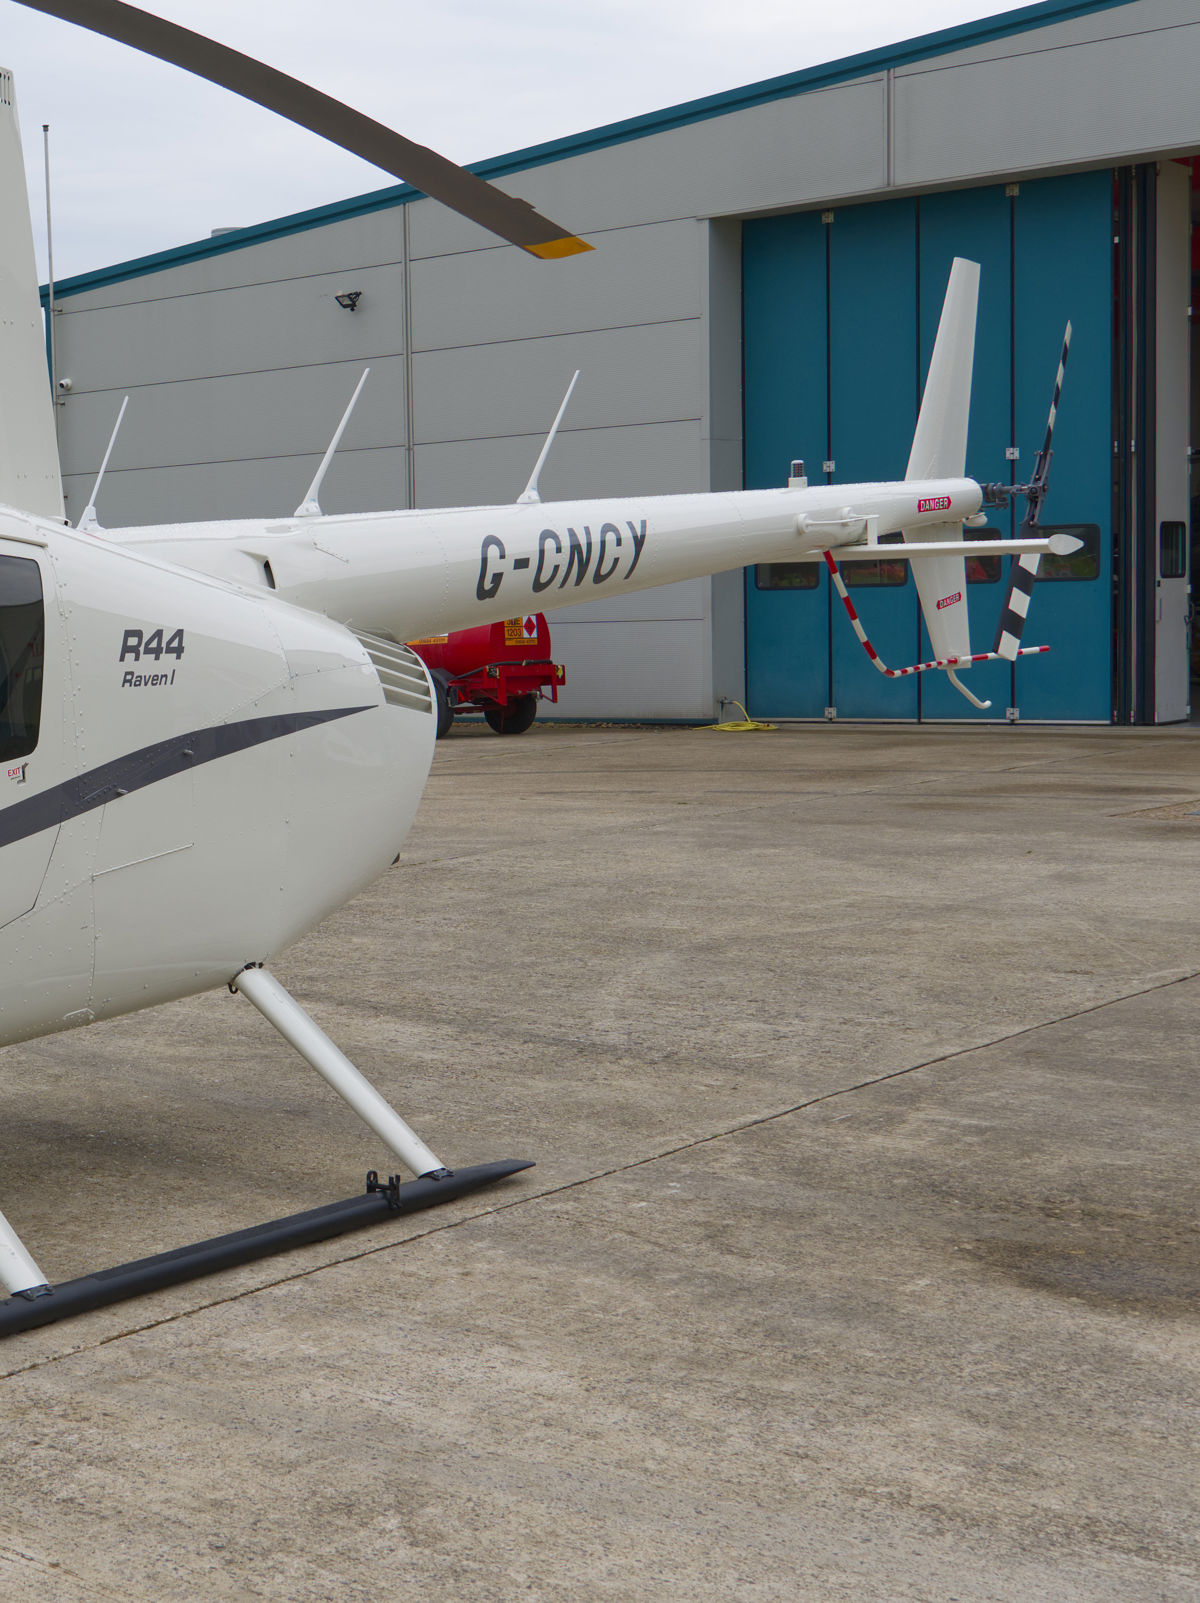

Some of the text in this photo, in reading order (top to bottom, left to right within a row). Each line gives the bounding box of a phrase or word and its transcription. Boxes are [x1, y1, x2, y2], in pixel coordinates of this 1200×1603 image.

[919, 497, 949, 512] DANGER
[476, 519, 647, 601] G-CNCY
[939, 592, 961, 609] DANGER
[506, 627, 522, 637] 1203
[119, 628, 185, 663] R44
[121, 668, 176, 688] Raven I
[7, 766, 21, 777] EXIT
